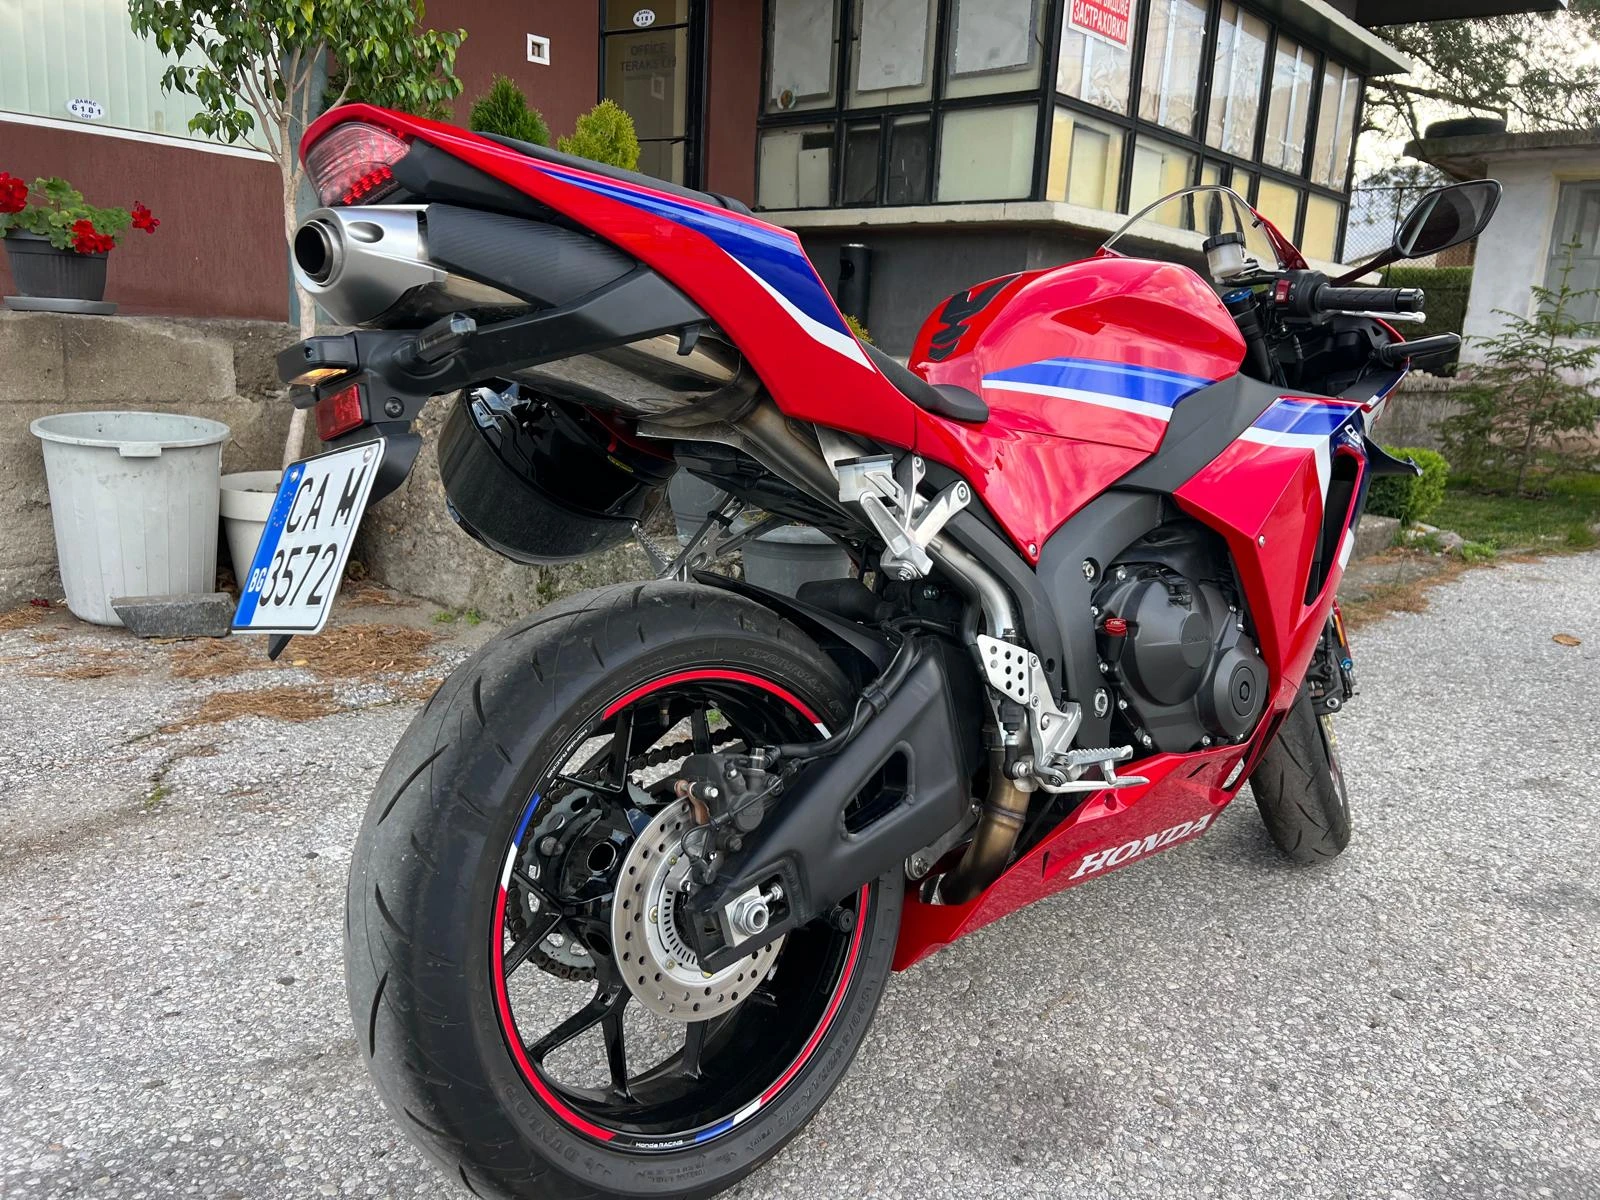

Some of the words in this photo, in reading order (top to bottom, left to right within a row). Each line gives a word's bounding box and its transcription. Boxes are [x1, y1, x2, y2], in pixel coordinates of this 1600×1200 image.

[1073, 0, 1127, 41] ЗАСТРАХОВКИ
[71, 104, 101, 115] 6181
[286, 473, 331, 533] CA
[331, 465, 368, 527] M
[247, 567, 268, 593] BG
[259, 543, 338, 607] 3572
[1068, 813, 1213, 880] HONDA
[635, 1141, 658, 1149] Honda
[658, 1139, 684, 1149] RACING
